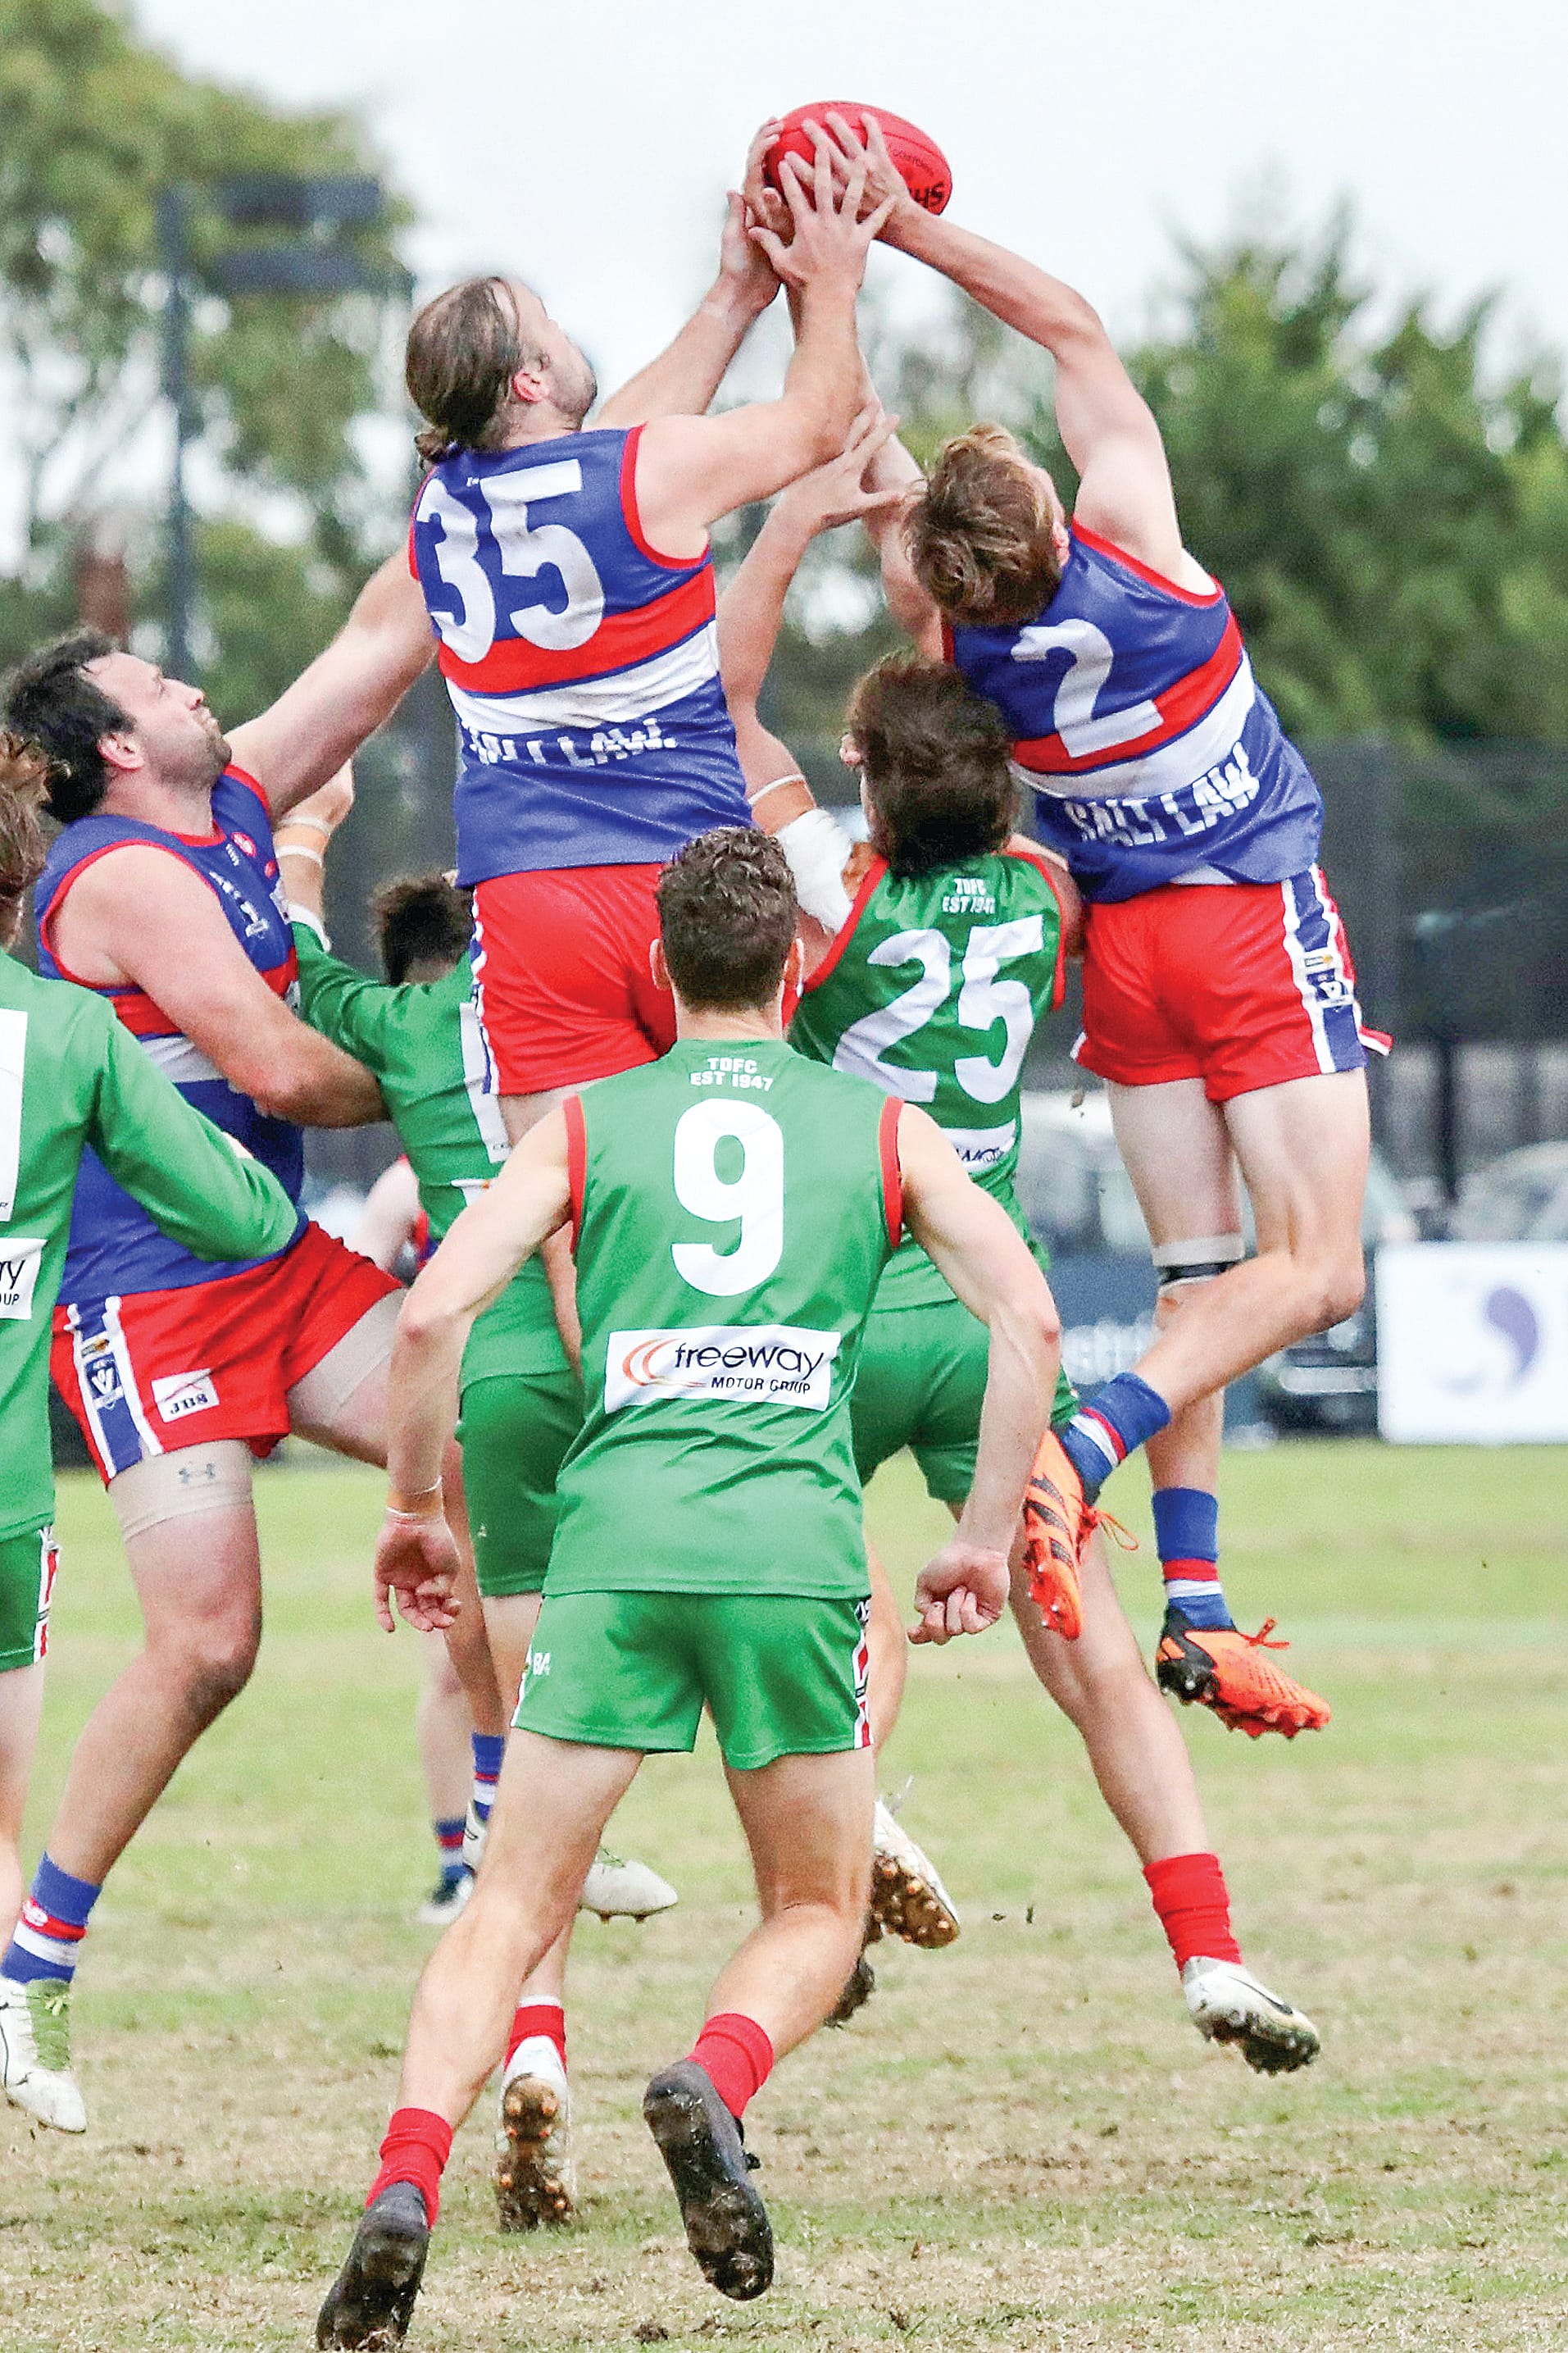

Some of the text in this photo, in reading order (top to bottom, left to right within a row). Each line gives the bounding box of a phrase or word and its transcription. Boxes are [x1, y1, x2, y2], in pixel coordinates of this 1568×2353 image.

[416, 458, 604, 662] 35
[1010, 618, 1164, 758] 2
[942, 895, 970, 913] EST
[832, 914, 1044, 1104] 25
[690, 1071, 774, 1092] EST 1947
[670, 1098, 784, 1296] 9
[675, 1342, 824, 1381] freeway
[711, 1377, 811, 1394] MOTOR GROUP
